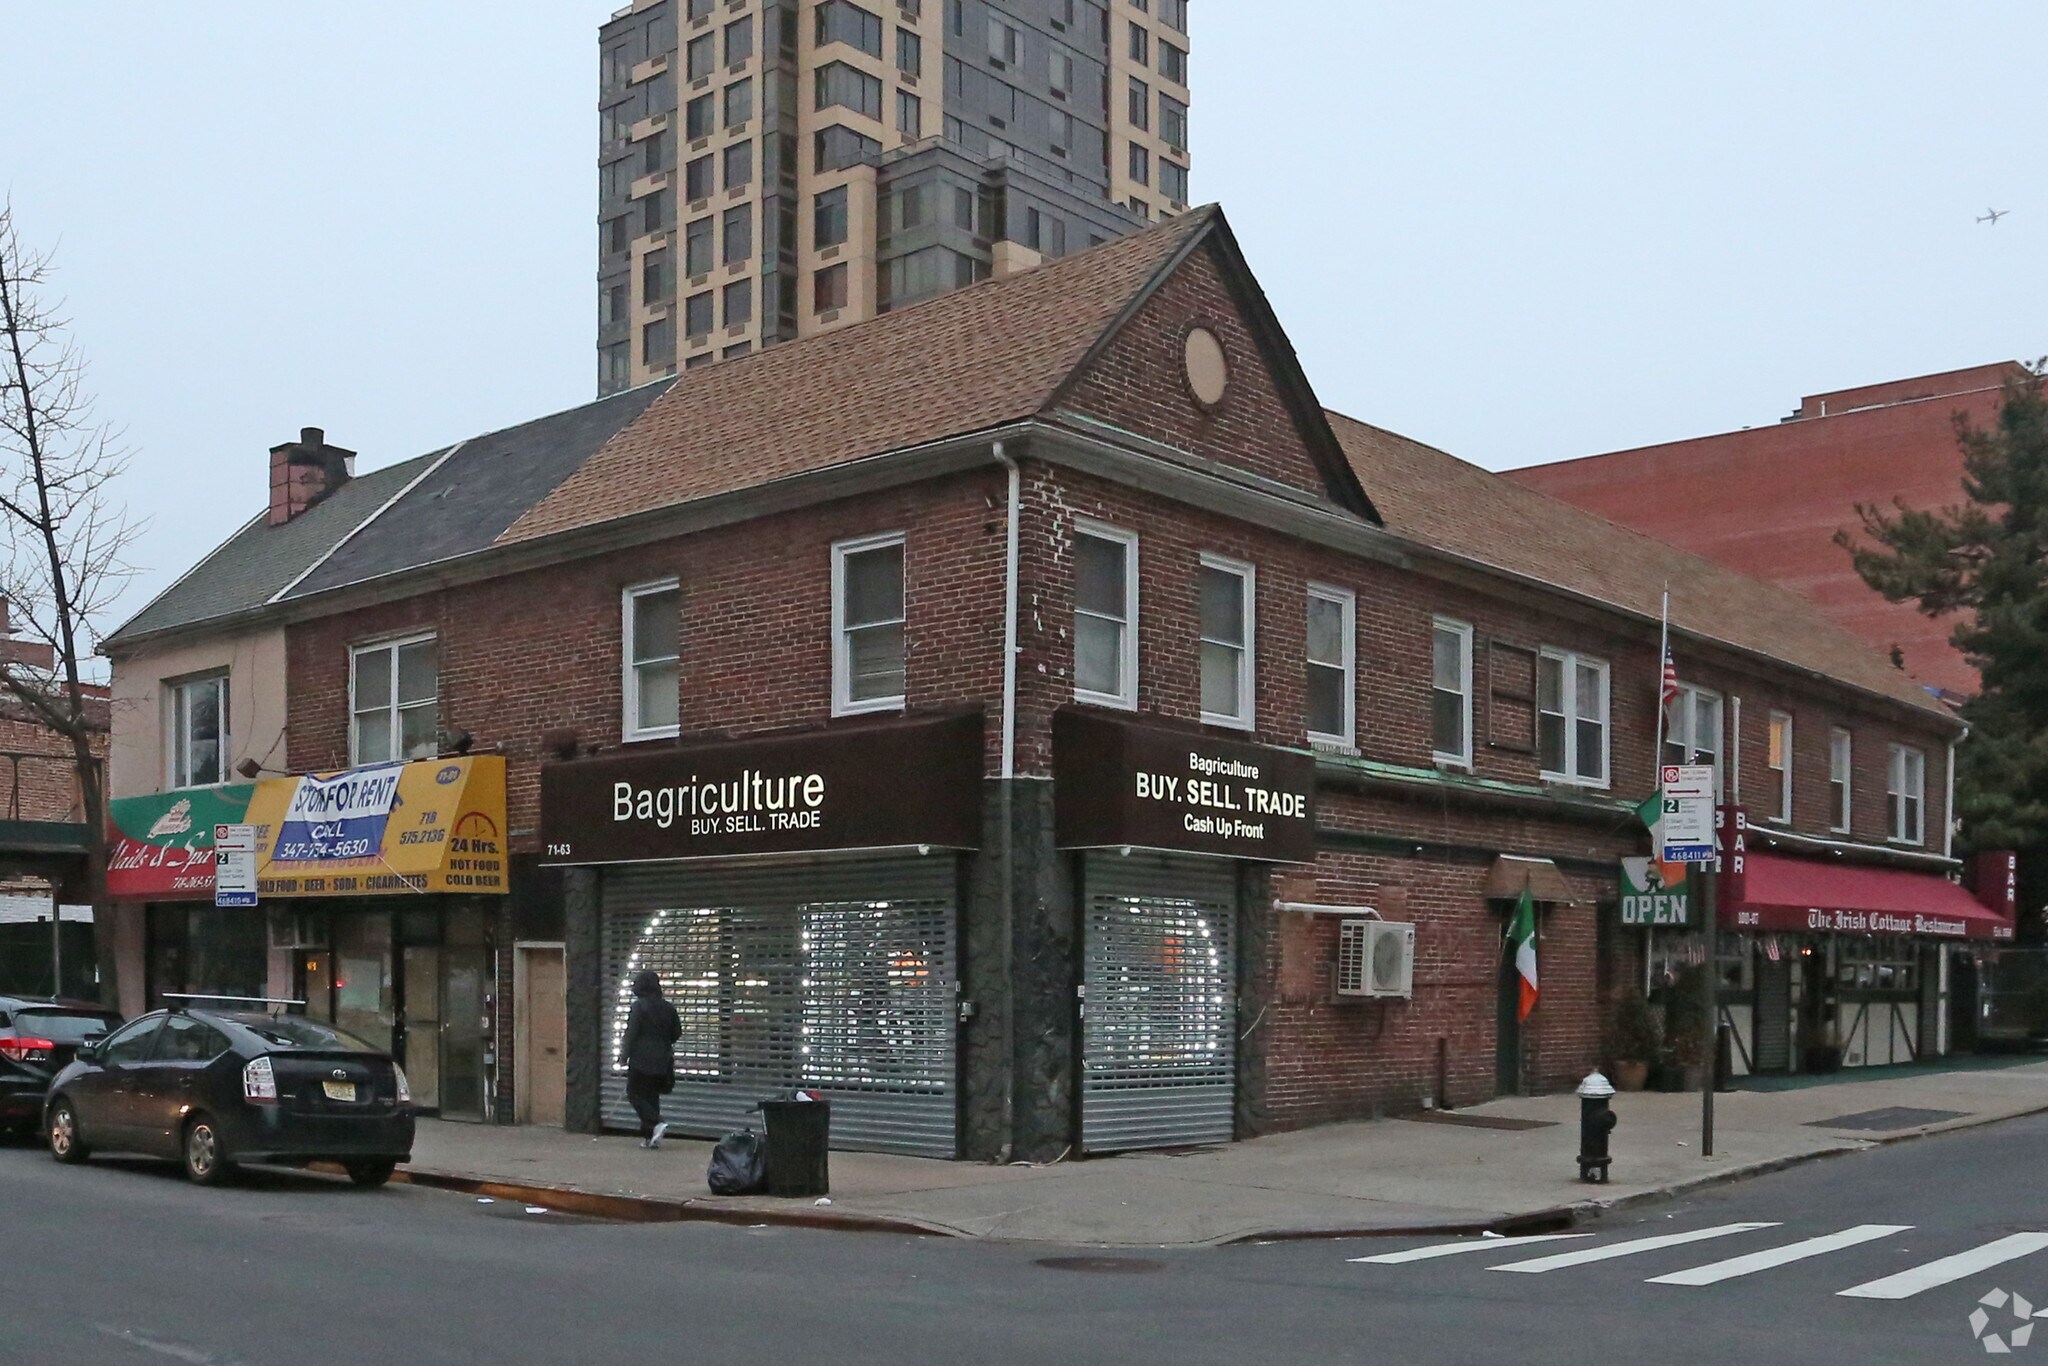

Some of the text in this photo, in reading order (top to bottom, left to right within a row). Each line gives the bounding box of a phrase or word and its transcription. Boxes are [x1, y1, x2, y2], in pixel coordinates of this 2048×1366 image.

[1189, 752, 1259, 779] Bagriculture
[357, 776, 396, 809] RENT
[614, 769, 825, 829] Bagriculture
[1136, 772, 1306, 819] BUY. SELL. TRADE
[419, 811, 438, 826] 718
[1666, 800, 1676, 813] 2
[311, 822, 345, 840] CALL
[691, 810, 821, 836] BUY. SELL. TRADE
[1184, 813, 1265, 840] Cash Up Front
[167, 830, 214, 874] Spa
[450, 838, 500, 854] 24 Hrs.
[547, 843, 571, 856] 71-63
[1733, 811, 1746, 874] BAR
[218, 853, 226, 864] 2
[450, 859, 500, 871] HOT FOOD
[304, 879, 325, 892] BEER
[333, 877, 357, 891] SODA
[445, 875, 500, 886] COLD BEER
[2006, 856, 2017, 902] BAR
[1622, 894, 1687, 924] OPEN
[1807, 908, 1832, 929] The
[1834, 910, 1867, 930] Irish
[1869, 912, 1912, 934] Cottage
